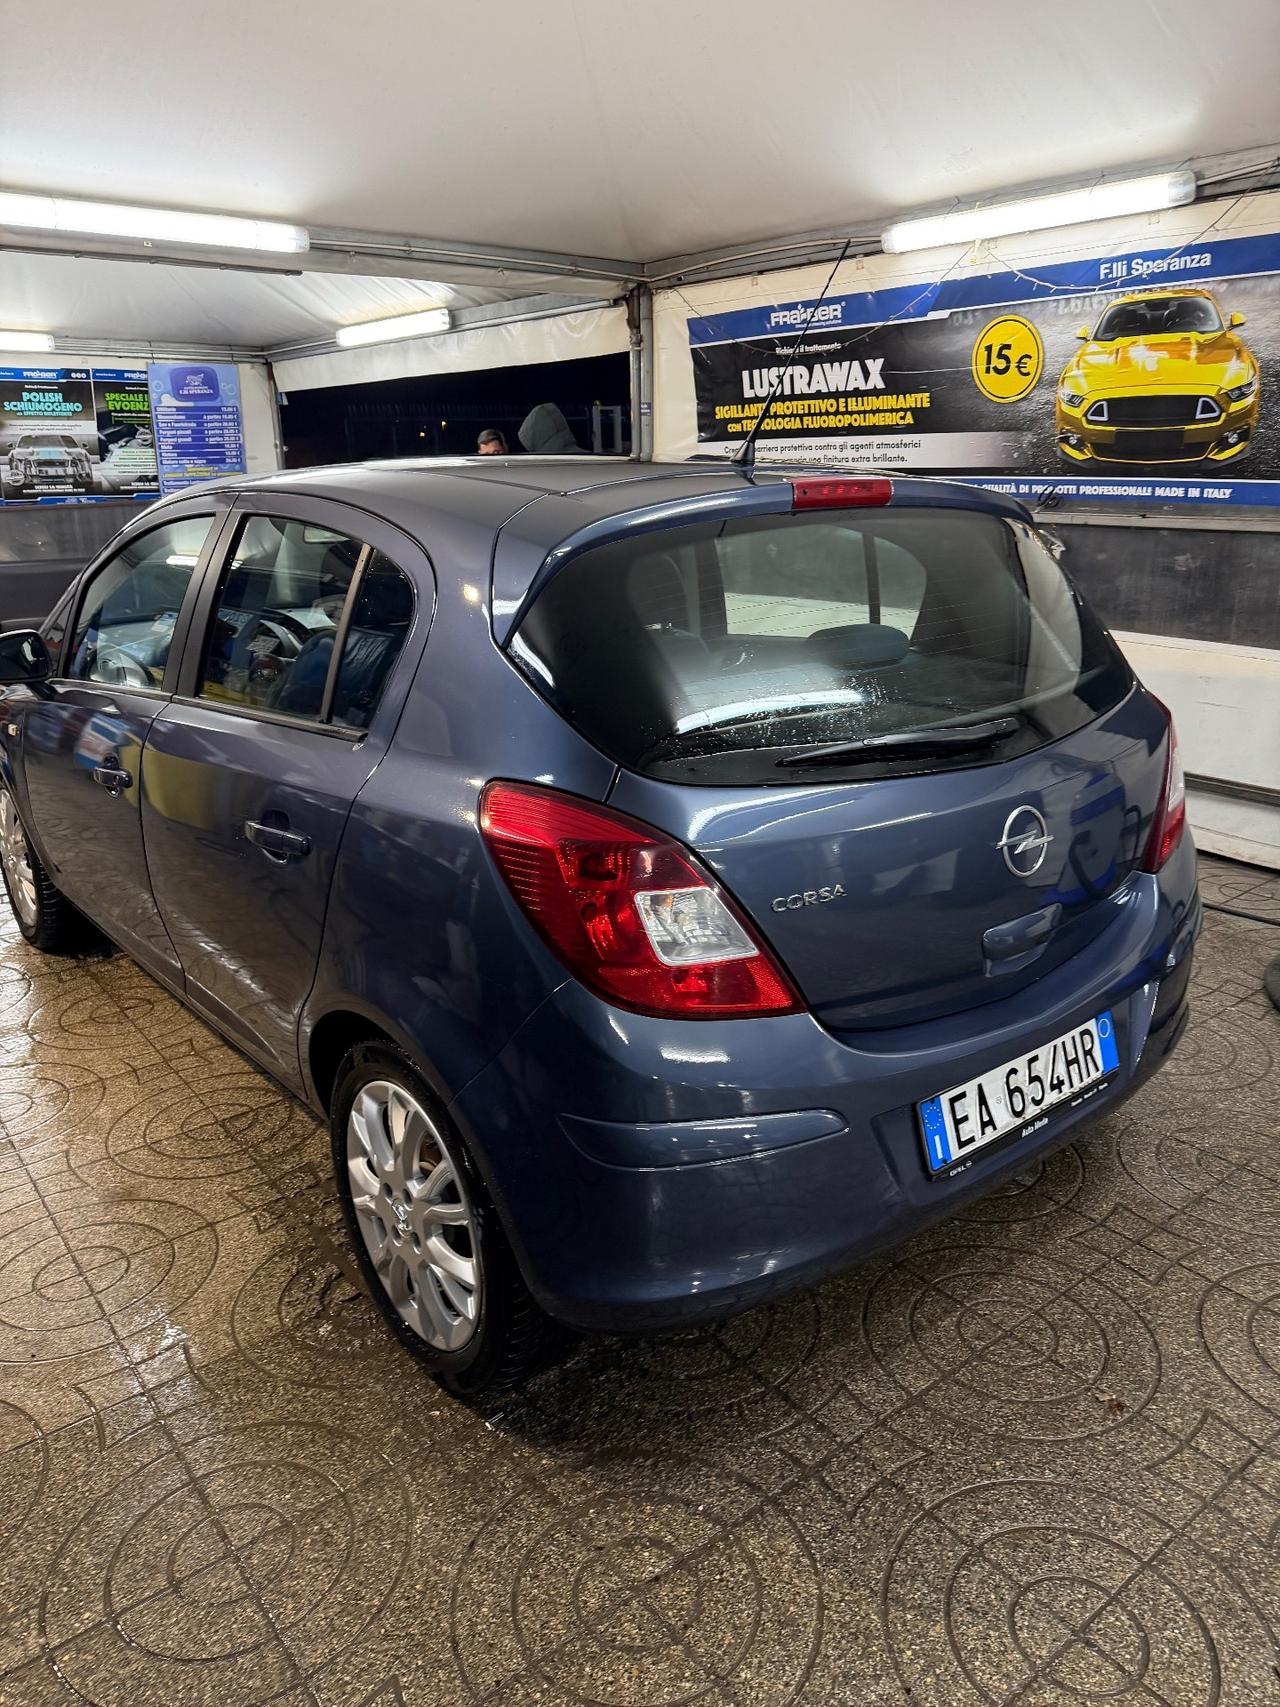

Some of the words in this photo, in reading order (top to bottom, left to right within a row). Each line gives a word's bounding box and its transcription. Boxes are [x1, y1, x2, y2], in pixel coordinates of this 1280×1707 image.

[1130, 252, 1212, 279] Speranza
[805, 342, 842, 352] trattamento
[983, 343, 1012, 377] 15
[1014, 353, 1032, 377] €
[741, 358, 886, 398] LUSTRAWAX
[22, 391, 63, 403] POLISH
[104, 392, 144, 402] SPECIALE
[770, 398, 837, 416] PROTETTIVO
[838, 398, 846, 412] E
[847, 393, 930, 411] ILLUMINANTE
[3, 401, 83, 412] SCHIUMOGENO
[742, 415, 802, 431] TECOLOGIA
[803, 411, 914, 429] FLUOROPOLIMERICA
[780, 444, 813, 455] protettiva
[838, 441, 848, 453] gli
[850, 440, 874, 453] agenti
[875, 440, 921, 449] atmosferici
[823, 454, 849, 463] finitura
[851, 454, 870, 462] extra
[872, 453, 907, 462] brillante.
[1019, 484, 1029, 494] DI
[1155, 487, 1185, 497] MADE
[1187, 488, 1201, 497] IN
[1203, 488, 1233, 498] ITALY
[771, 884, 848, 912] CORSA
[948, 1083, 998, 1151] EA
[1004, 1028, 1100, 1119] 654HR
